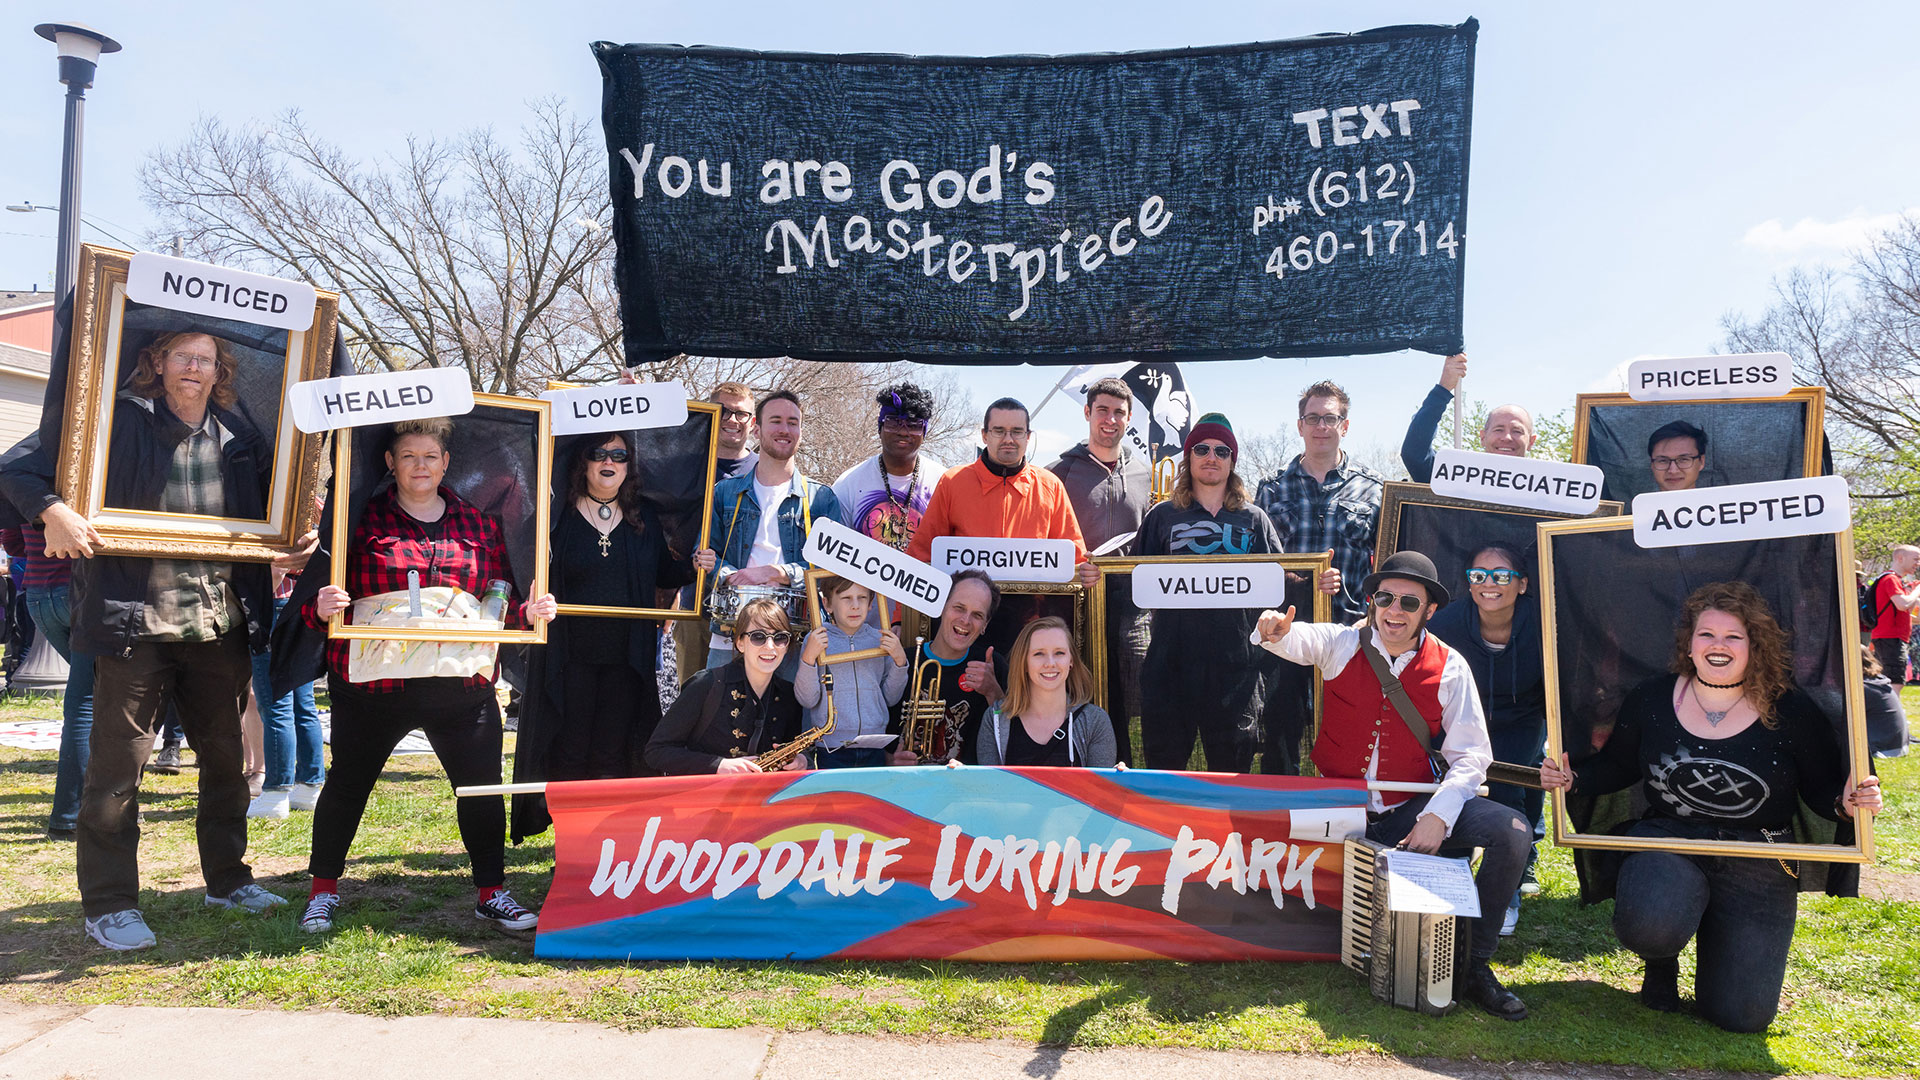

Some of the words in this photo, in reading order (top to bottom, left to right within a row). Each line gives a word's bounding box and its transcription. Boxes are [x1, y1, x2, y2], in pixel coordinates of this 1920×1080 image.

[1293, 99, 1421, 148] TEXT
[622, 143, 731, 198] You
[760, 159, 852, 203] are
[880, 145, 1054, 212] God's
[1252, 195, 1303, 236] ph#
[1308, 161, 1415, 216] (612)
[765, 196, 1173, 321] Masterpiece
[1266, 220, 1458, 279] 460-1714
[163, 272, 287, 313] NOTICED
[1642, 366, 1777, 388] PRICELESS
[324, 386, 432, 414] HEALED
[574, 397, 650, 418] LOVED
[1434, 463, 1597, 500] APPRECIATED
[1652, 495, 1824, 531] ACCEPTED
[816, 532, 940, 604] WELCOMED
[947, 549, 1058, 568] FORGIVEN
[1159, 577, 1251, 594] VALUED
[1323, 820, 1331, 838] 1
[589, 817, 910, 899] WOODDALE
[930, 824, 1140, 910] LORING
[1161, 825, 1323, 915] PARK
